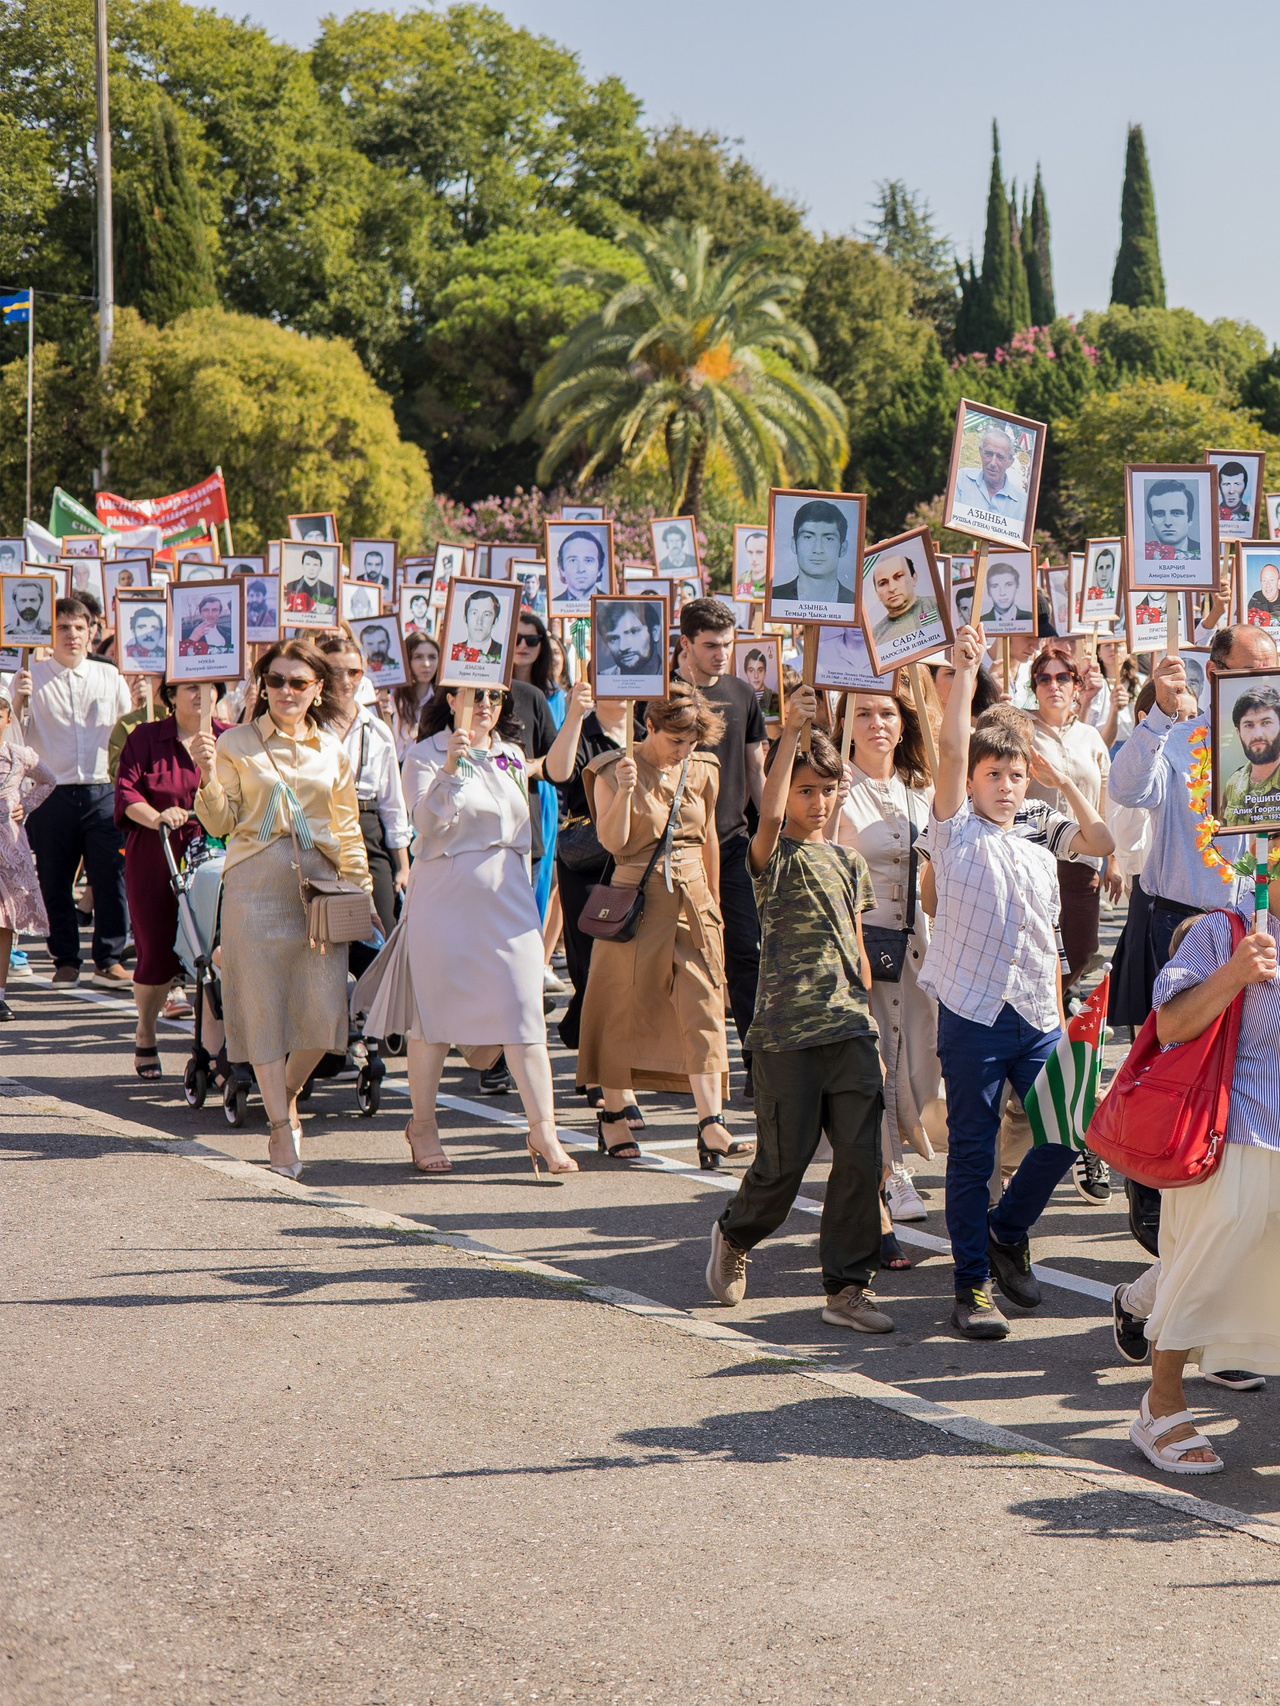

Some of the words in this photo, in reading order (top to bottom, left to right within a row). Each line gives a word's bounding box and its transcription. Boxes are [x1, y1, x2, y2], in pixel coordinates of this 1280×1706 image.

[967, 507, 1007, 527] АЗЫНБА
[798, 603, 828, 611] АЗЫНБА
[892, 630, 925, 648] САБУА
[880, 646, 910, 661] ИАРОСЛАВ
[1233, 807, 1253, 815] Алик
